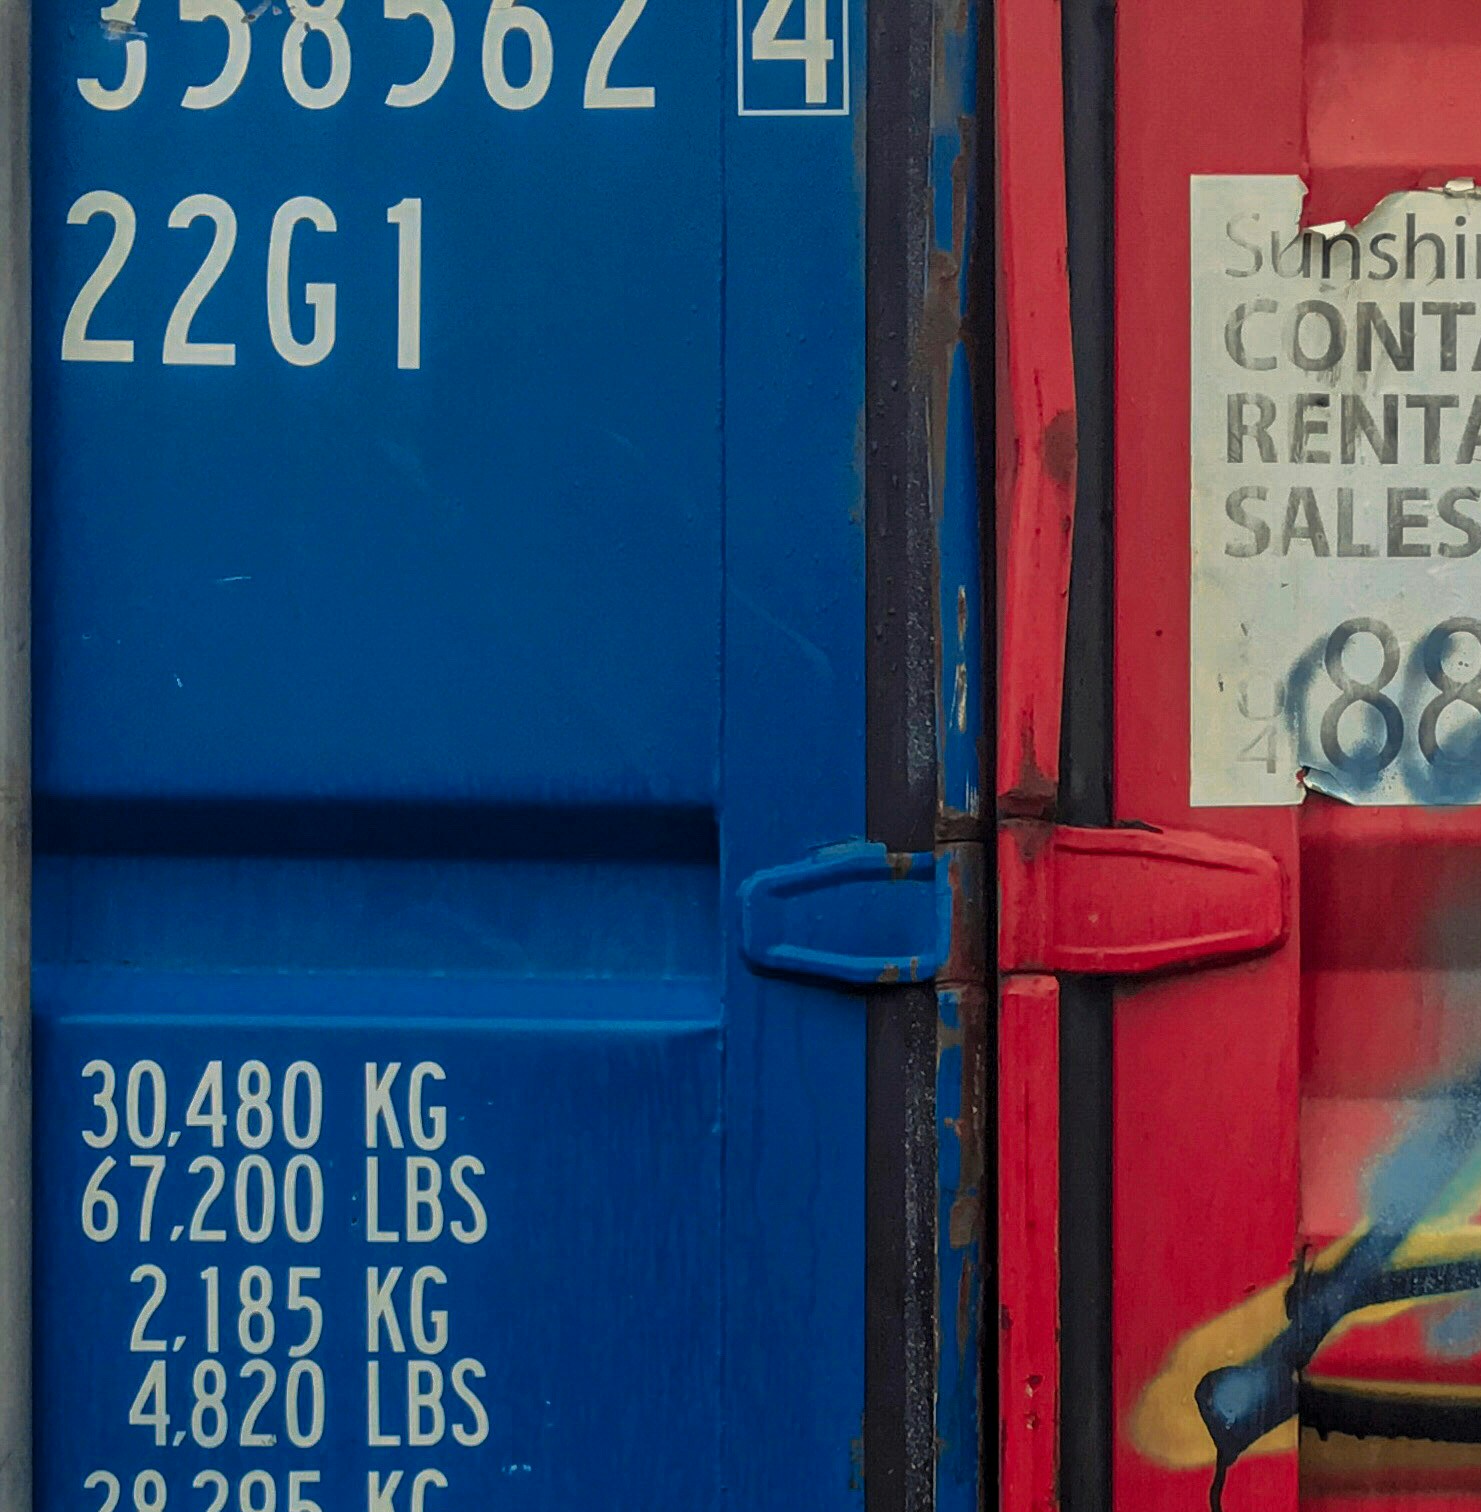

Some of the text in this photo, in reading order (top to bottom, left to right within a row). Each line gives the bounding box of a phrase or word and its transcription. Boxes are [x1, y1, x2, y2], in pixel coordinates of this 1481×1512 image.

[78, 0, 833, 110] 358562 4
[62, 191, 421, 369] 22G1
[83, 1060, 445, 1150] 30,480 KG
[82, 1155, 486, 1243] 67,200 LBS
[131, 1265, 447, 1356] 2,185 KG
[130, 1359, 488, 1447] 4,820 LBS
